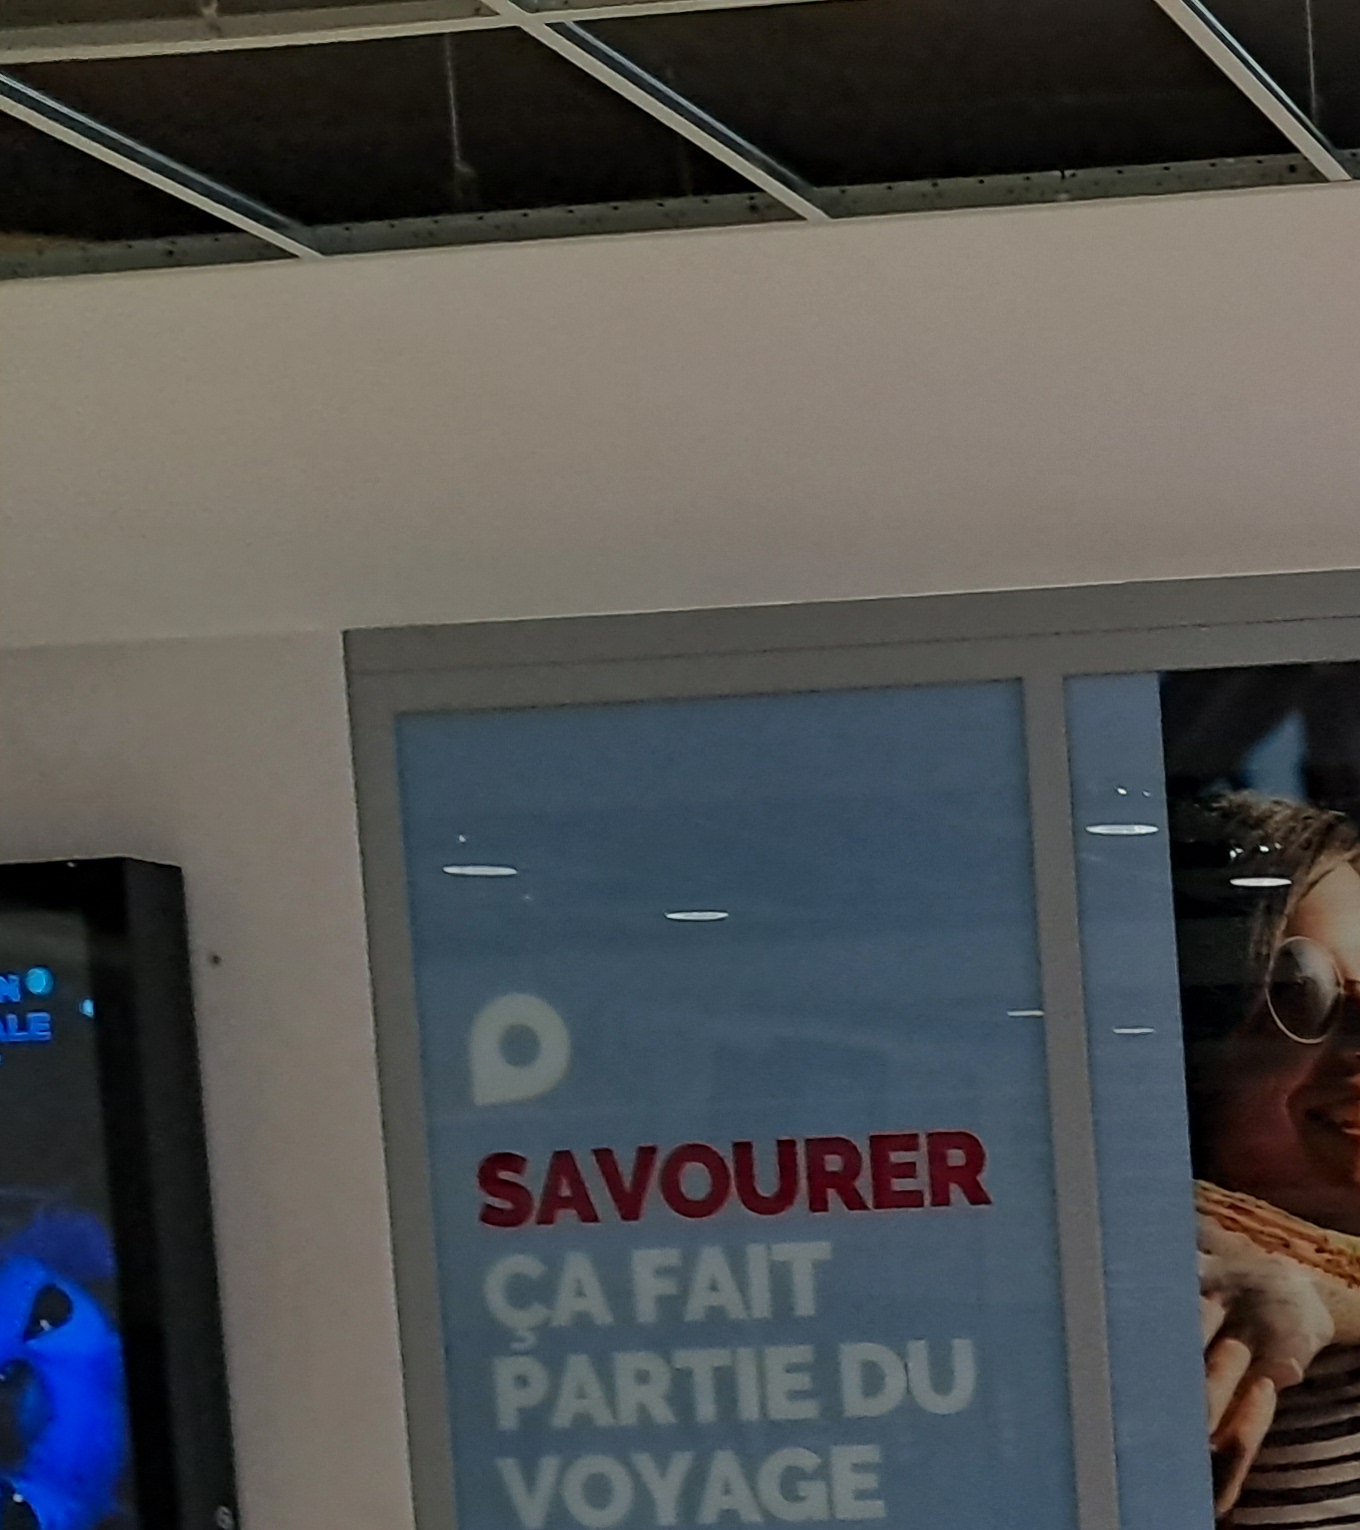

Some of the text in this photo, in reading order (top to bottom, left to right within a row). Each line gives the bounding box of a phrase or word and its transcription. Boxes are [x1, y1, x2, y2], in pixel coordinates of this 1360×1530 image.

[0, 1012, 52, 1042] LE
[477, 1130, 992, 1229] SAVOURER
[484, 1242, 833, 1350] ÇA FAIT
[492, 1337, 978, 1431] PARTIE DU
[496, 1444, 887, 1530] VOYAGE
